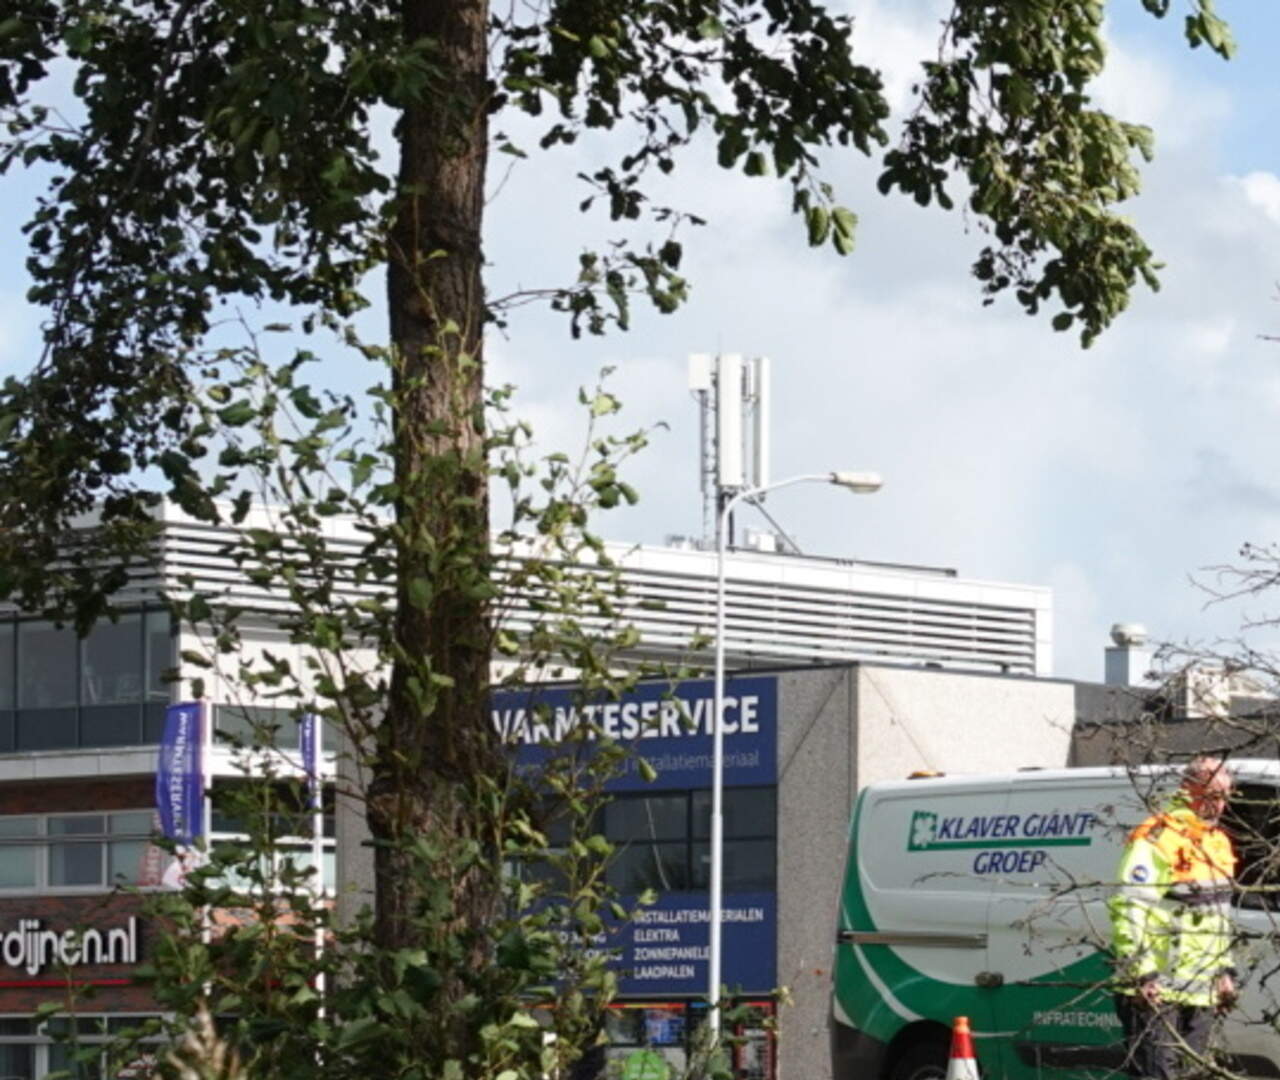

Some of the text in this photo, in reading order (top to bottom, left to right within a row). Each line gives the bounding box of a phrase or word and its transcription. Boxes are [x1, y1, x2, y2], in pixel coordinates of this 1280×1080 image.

[938, 813, 1093, 839] KLAVER GIANT
[973, 850, 1047, 874] GROEP
[633, 908, 764, 924] INSTALLATIEMAERIALEN
[633, 928, 680, 943] ELEKTRA
[0, 916, 136, 976] dijnen.nl
[633, 946, 711, 961] ZONNEPANELE
[633, 965, 695, 980] LAADPALEN
[1033, 1010, 1123, 1028] INFRATECHNI
